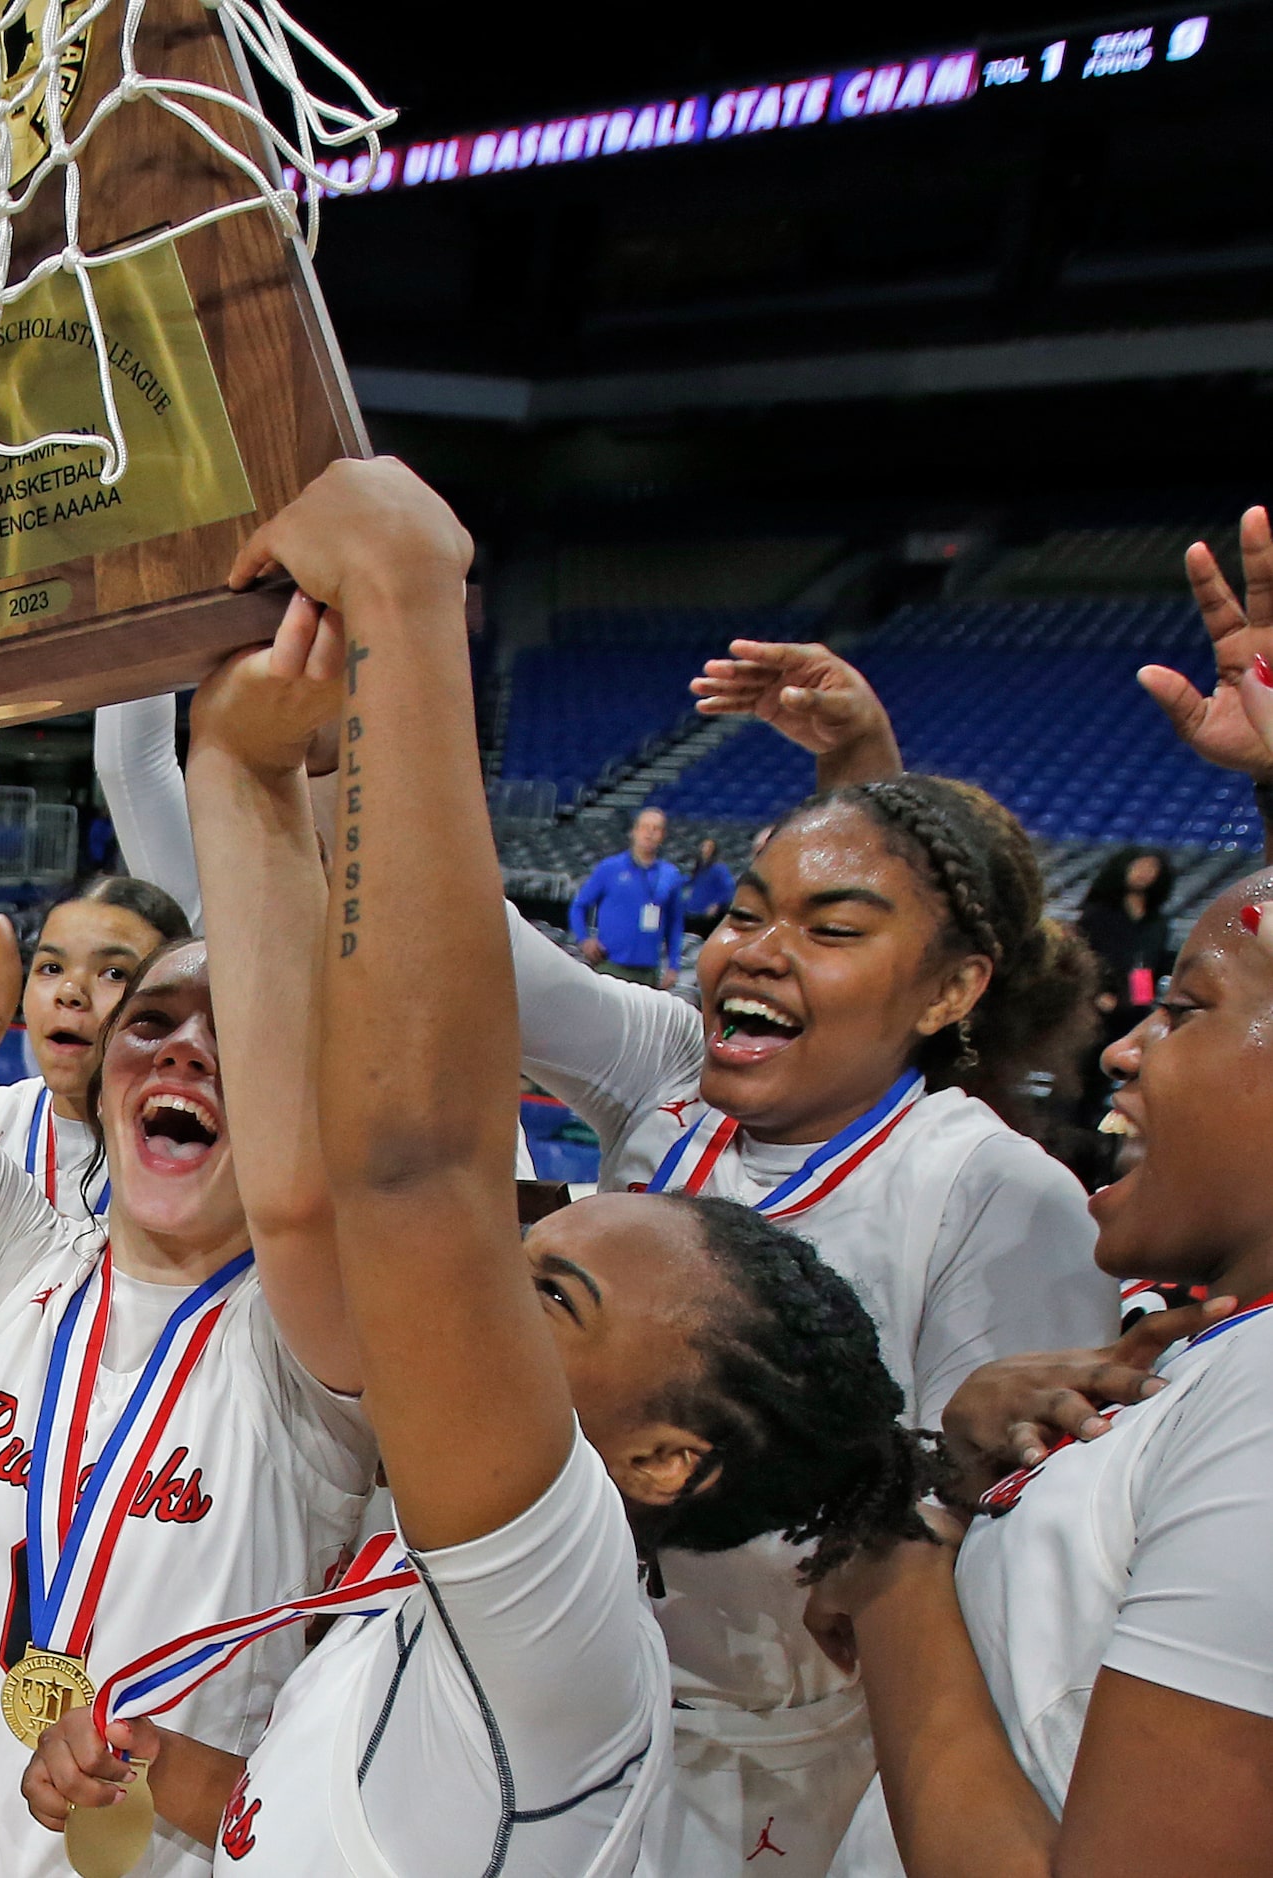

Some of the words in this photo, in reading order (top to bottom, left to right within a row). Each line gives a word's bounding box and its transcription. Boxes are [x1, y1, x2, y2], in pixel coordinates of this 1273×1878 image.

[1041, 40, 1066, 82] 1
[402, 138, 459, 186] UIL
[468, 98, 697, 177] BASKETBALL
[706, 75, 832, 139] STATE
[840, 53, 974, 118] CHAM
[108, 341, 172, 415] LEAGUE
[54, 486, 122, 523] AAAAA
[9, 590, 49, 617] 2023
[340, 716, 363, 959] BLESSED
